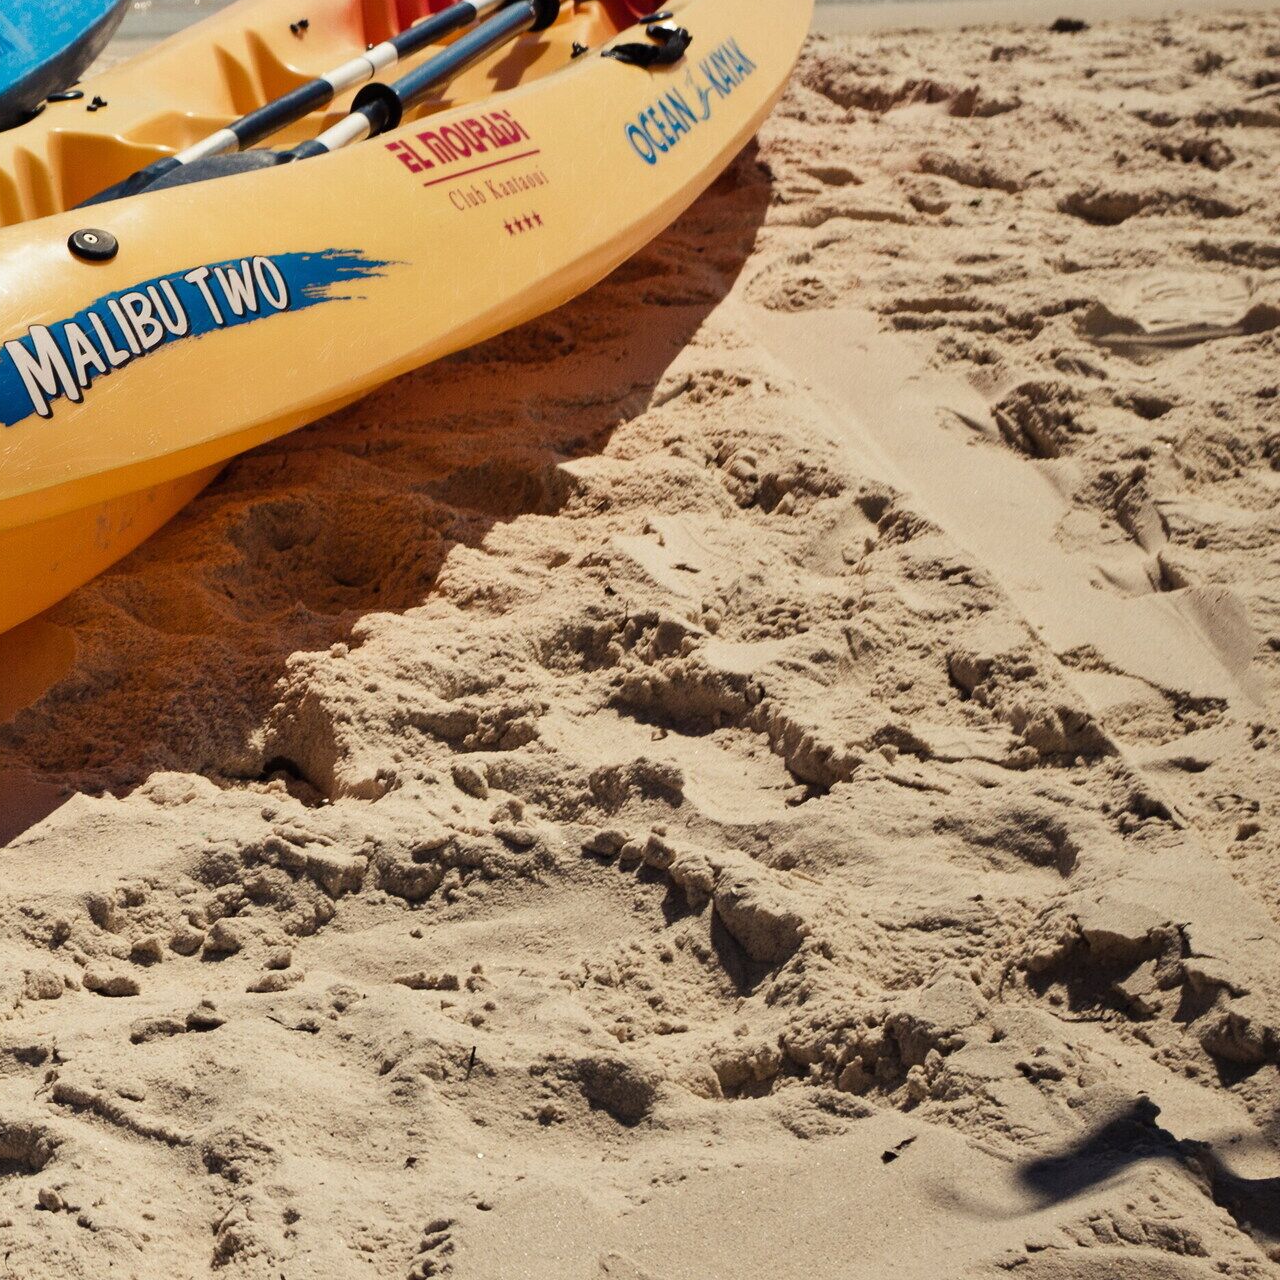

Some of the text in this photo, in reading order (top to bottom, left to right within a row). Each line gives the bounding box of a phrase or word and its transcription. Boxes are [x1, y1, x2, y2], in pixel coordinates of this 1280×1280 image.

[623, 36, 757, 166] OCEAN KAYAK
[384, 140, 435, 173] EL
[448, 165, 550, 211] Club Kantaoui
[2, 255, 290, 419] MALIBU TWO
